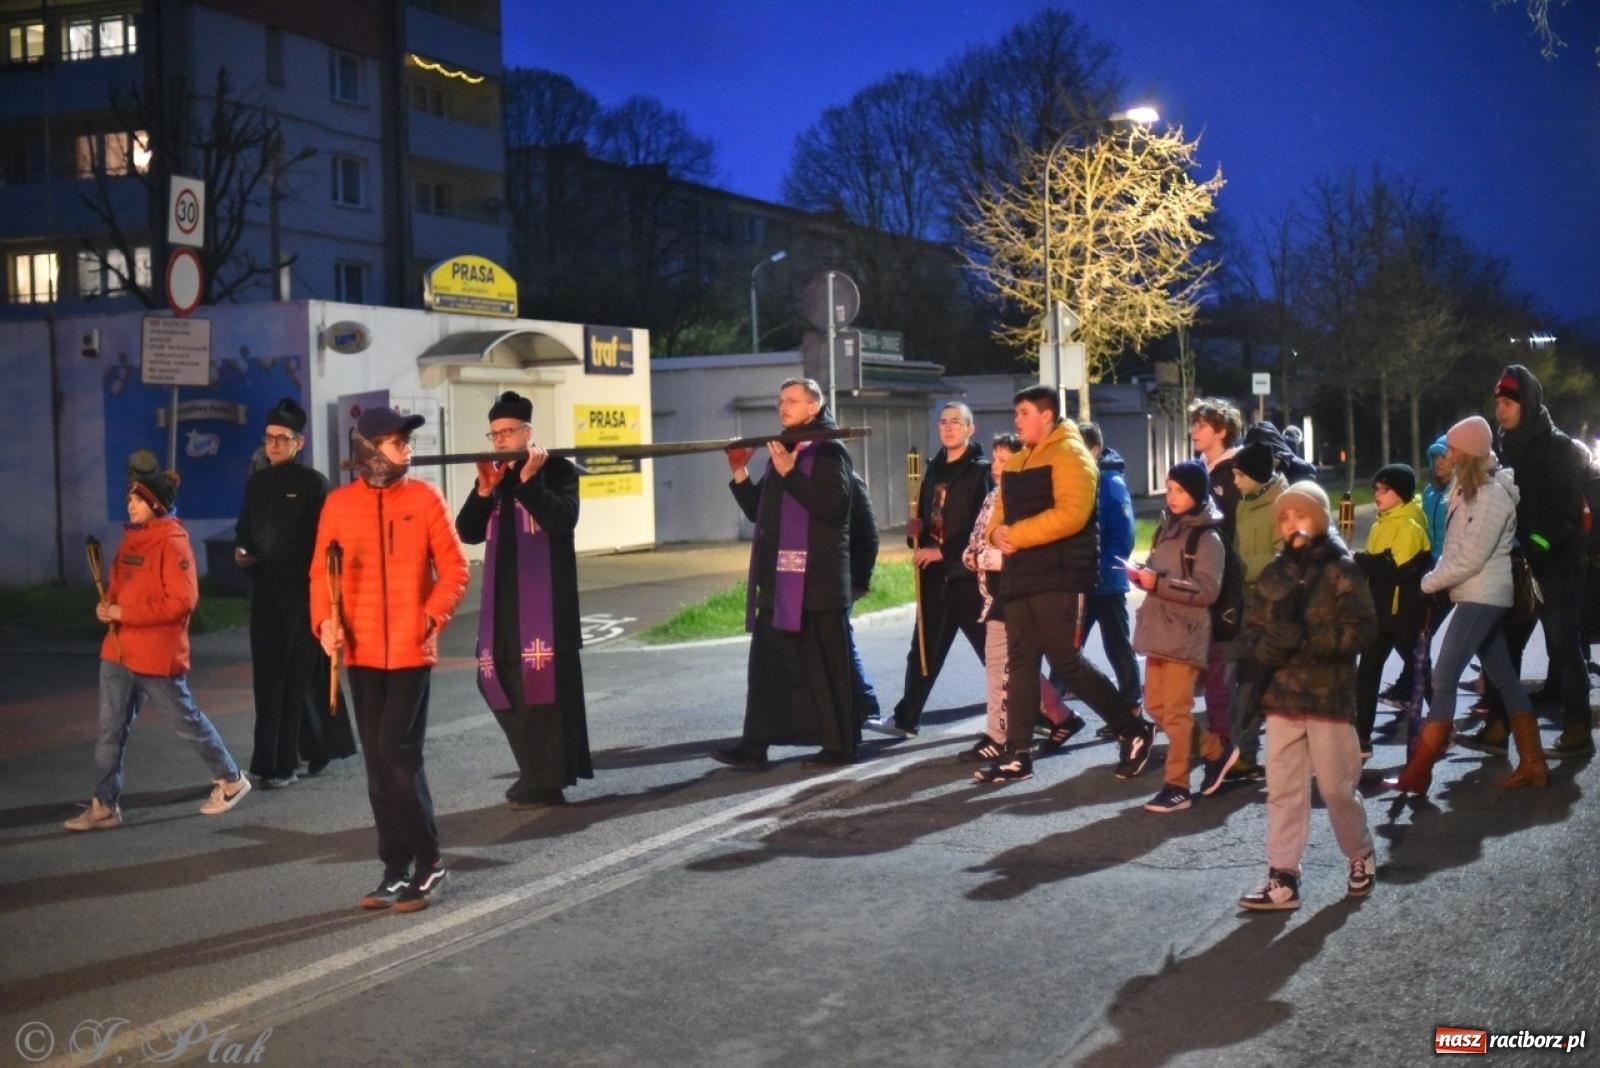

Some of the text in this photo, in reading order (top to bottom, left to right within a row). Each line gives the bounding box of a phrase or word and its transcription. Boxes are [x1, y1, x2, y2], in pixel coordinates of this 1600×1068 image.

[179, 200, 196, 223] 30
[452, 262, 495, 285] PRASA
[589, 410, 626, 429] PRASA
